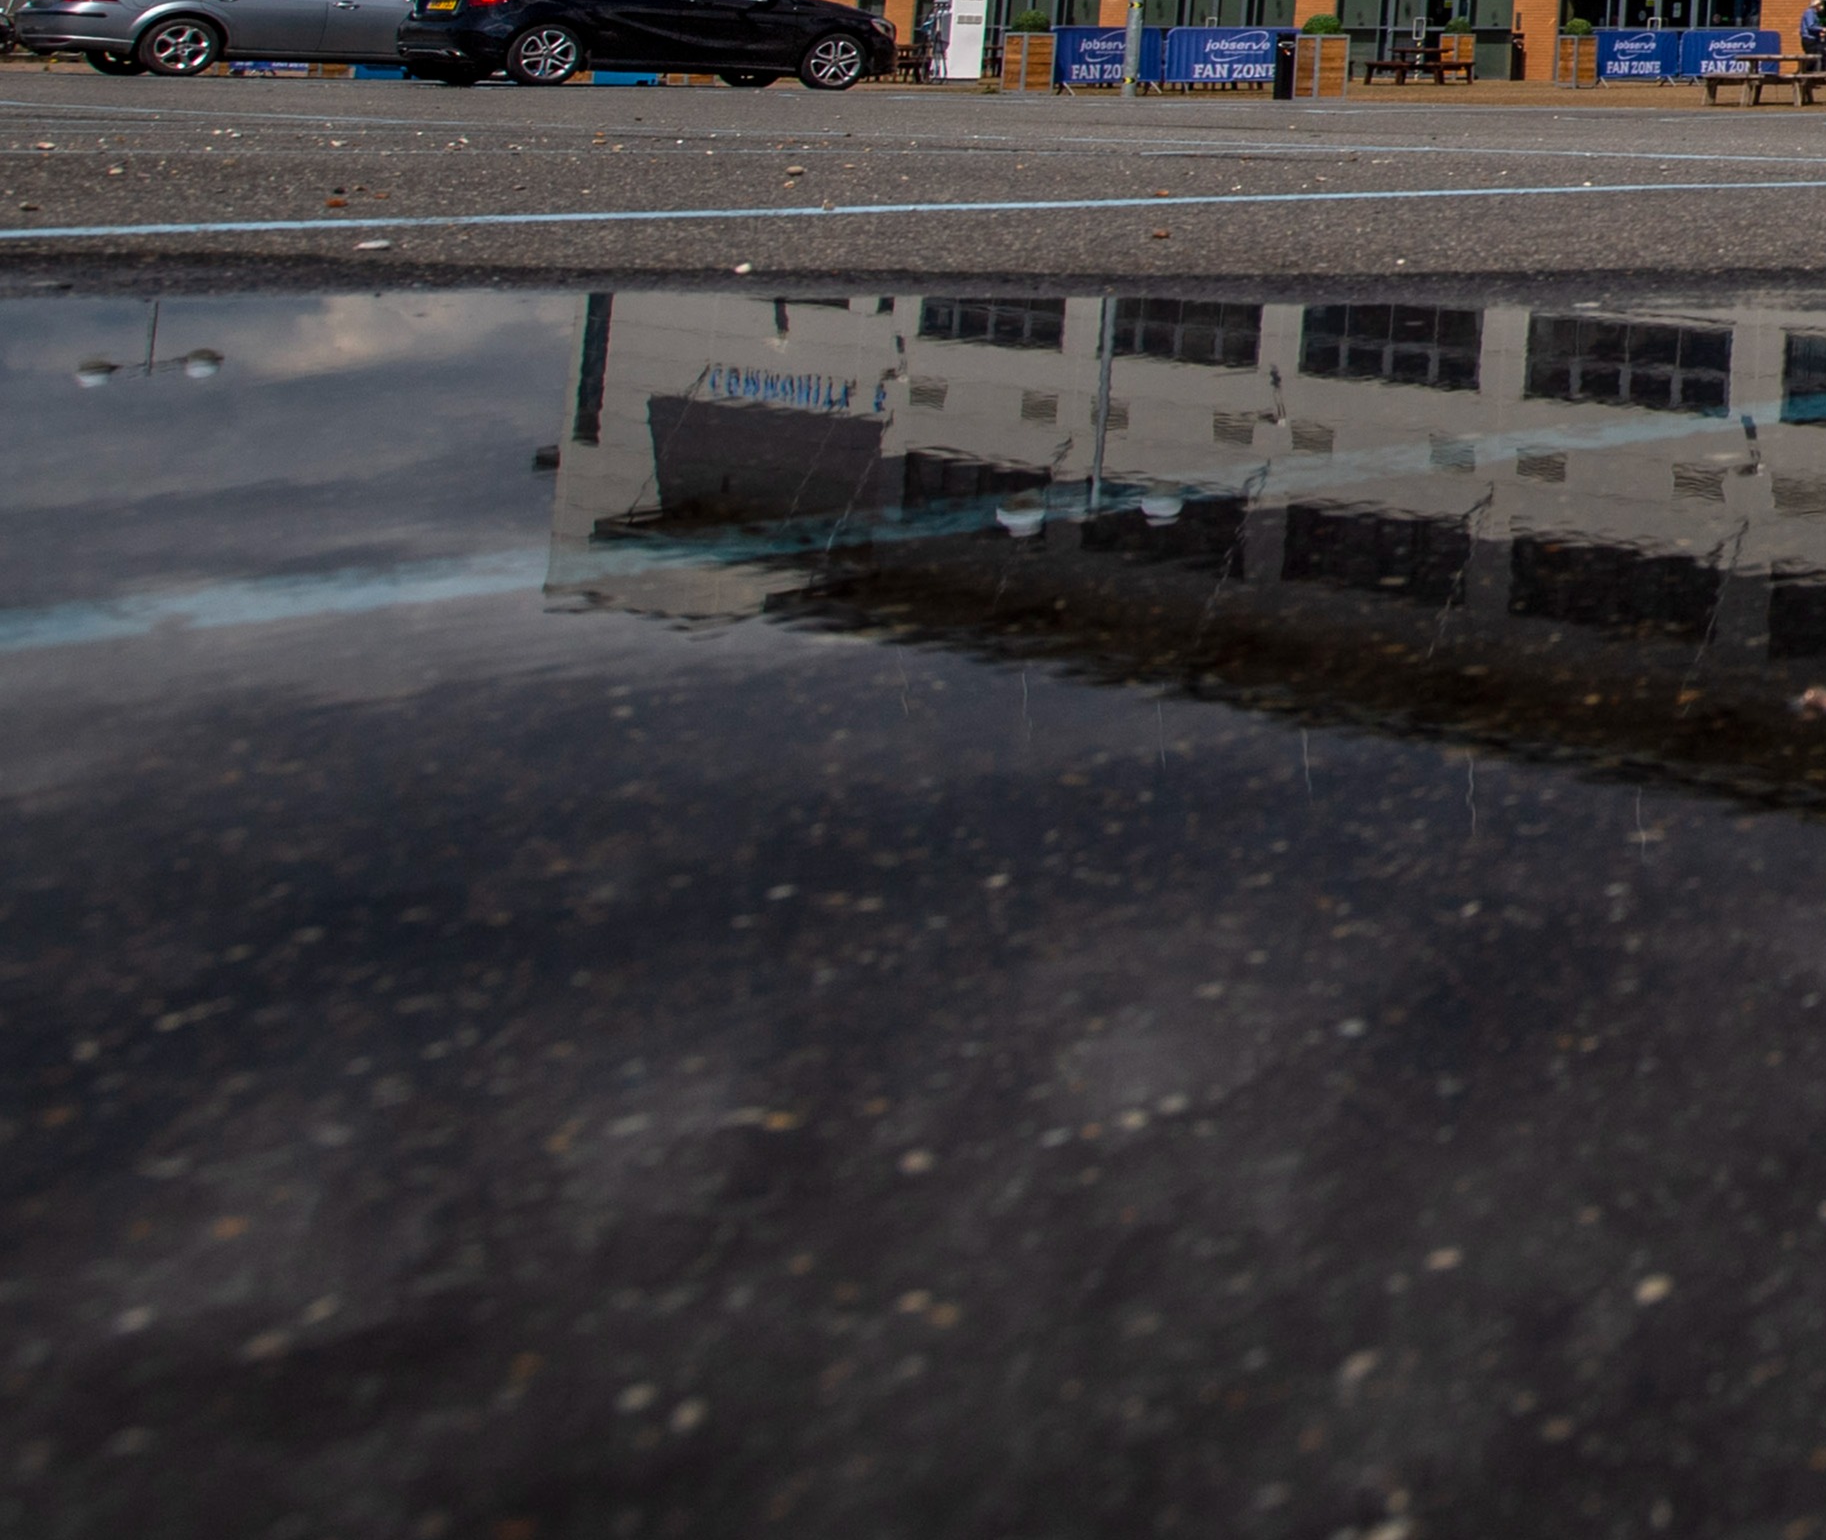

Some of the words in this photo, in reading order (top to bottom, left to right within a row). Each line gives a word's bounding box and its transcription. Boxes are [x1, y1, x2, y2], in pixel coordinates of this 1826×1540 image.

[1080, 38, 1128, 53] jobserv
[1205, 38, 1271, 53] jobserve
[1613, 39, 1656, 52] jobserve
[1708, 39, 1756, 52] jobserve
[1071, 63, 1101, 79] FAN
[1193, 63, 1230, 79] FAN
[1232, 63, 1276, 78] ZONE
[1606, 61, 1630, 74] FAN
[1631, 61, 1661, 74] ZONE
[1701, 60, 1728, 73] FAN
[1728, 60, 1761, 73] ZON
